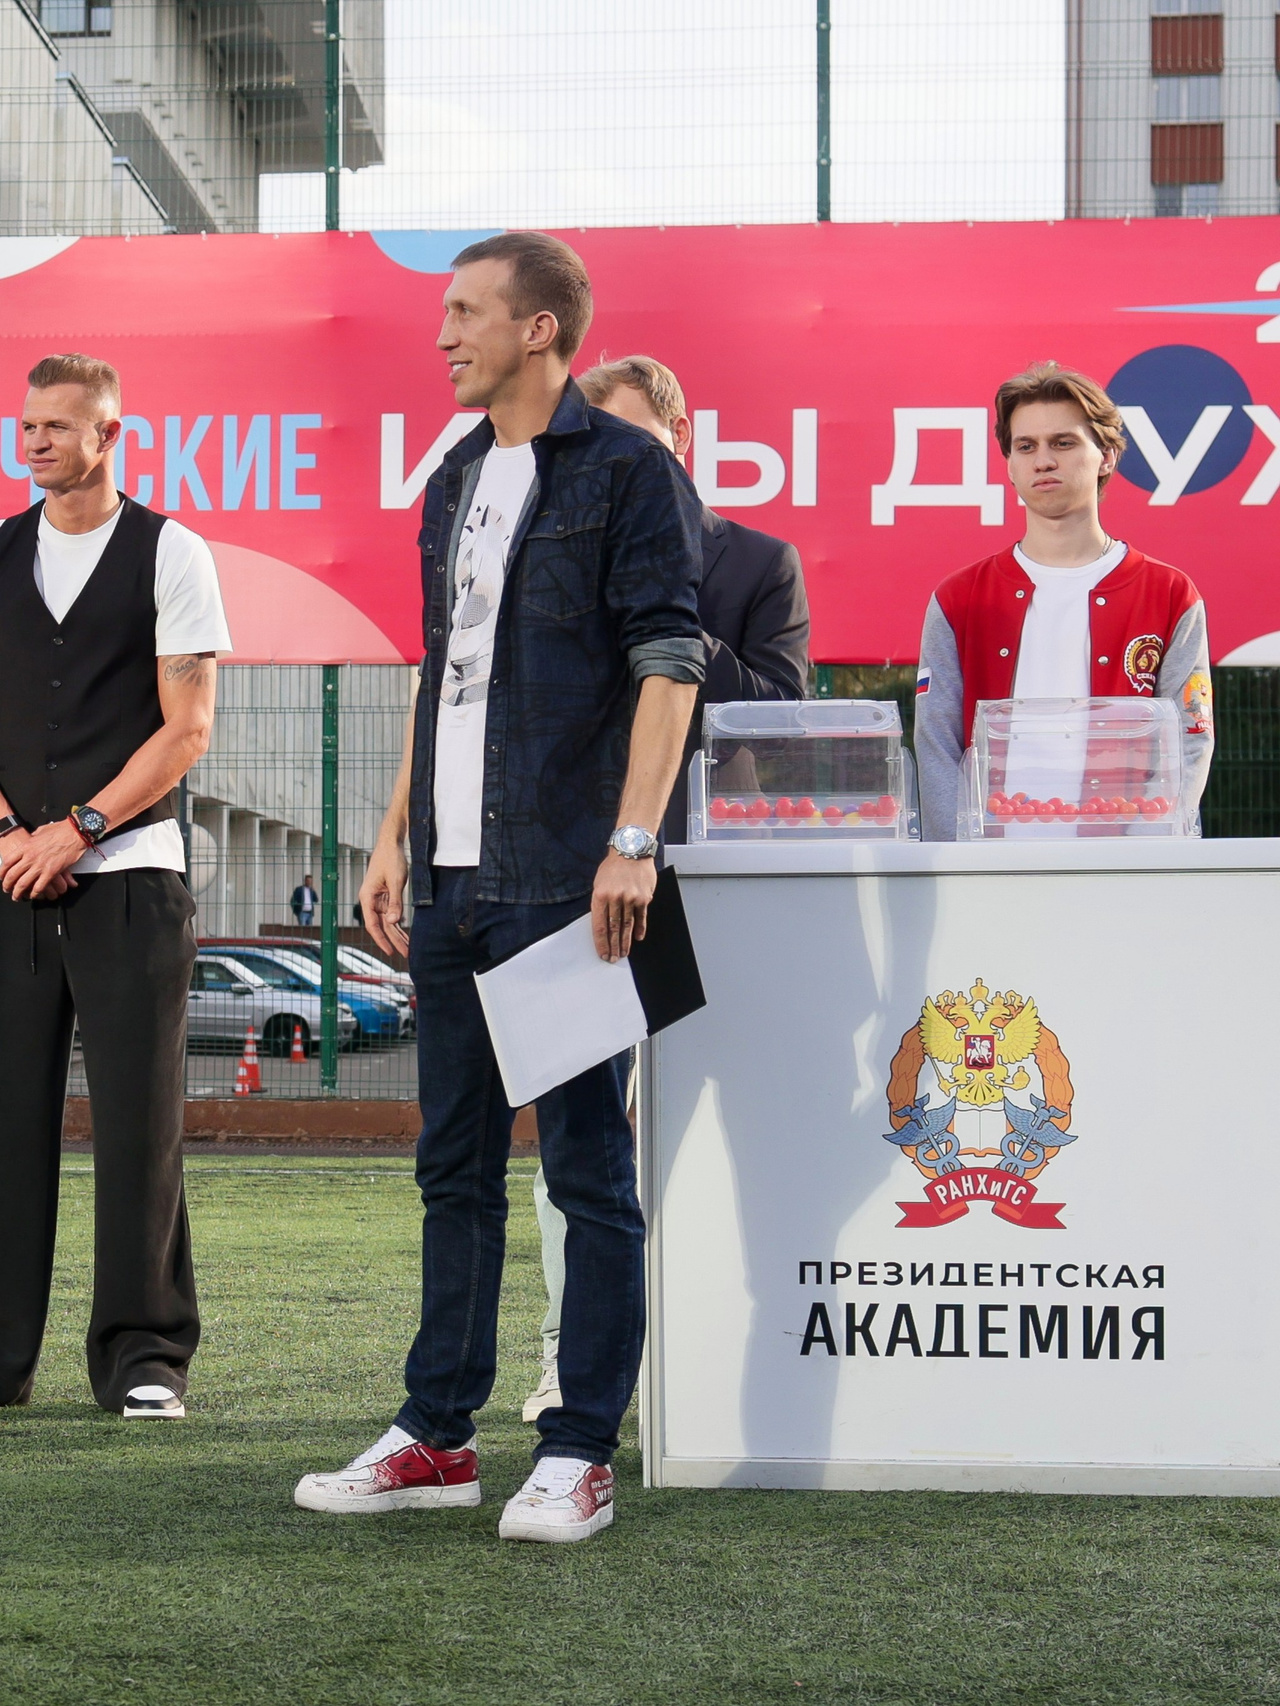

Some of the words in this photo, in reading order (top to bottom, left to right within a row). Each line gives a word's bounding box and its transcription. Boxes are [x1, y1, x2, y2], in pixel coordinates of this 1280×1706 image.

[380, 408, 818, 510] ИЫ
[934, 1173, 1027, 1206] РАНХиГС
[798, 1261, 1165, 1289] ПРЕЗИДЕНТСКАЯ
[799, 1302, 1165, 1361] АКАДЕМИЯ
